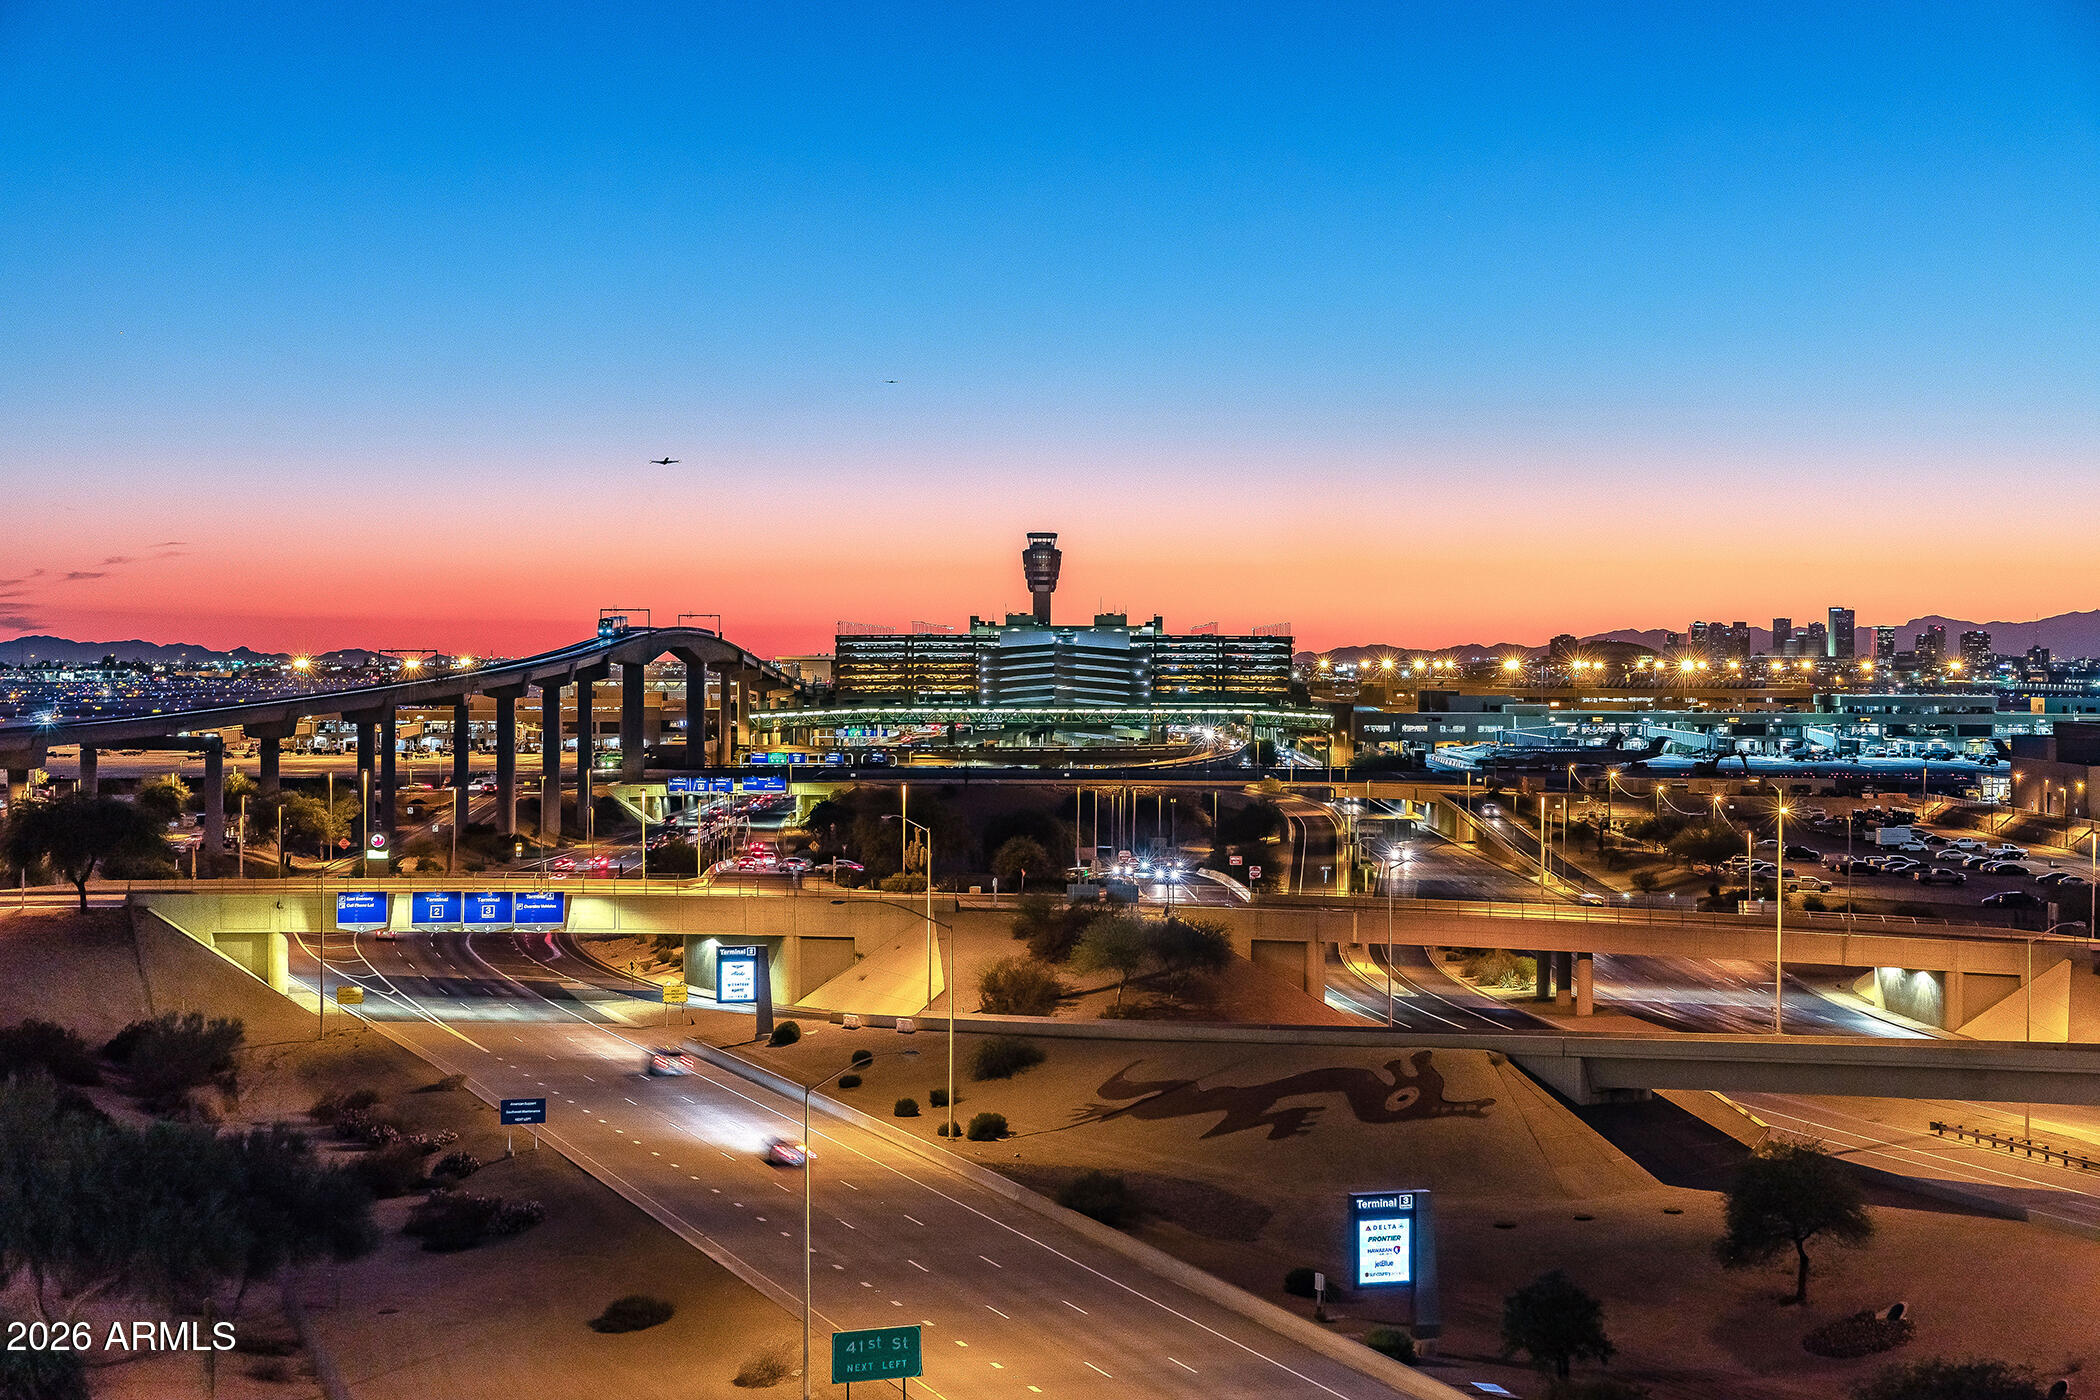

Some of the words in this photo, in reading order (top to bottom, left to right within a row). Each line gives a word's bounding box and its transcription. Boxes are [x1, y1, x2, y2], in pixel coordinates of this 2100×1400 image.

[1356, 1198, 1397, 1208] Terminal
[846, 1336, 881, 1352] 41st
[892, 1337, 908, 1350] St
[846, 1362, 874, 1372] NEXT
[882, 1360, 907, 1370] LEFT
